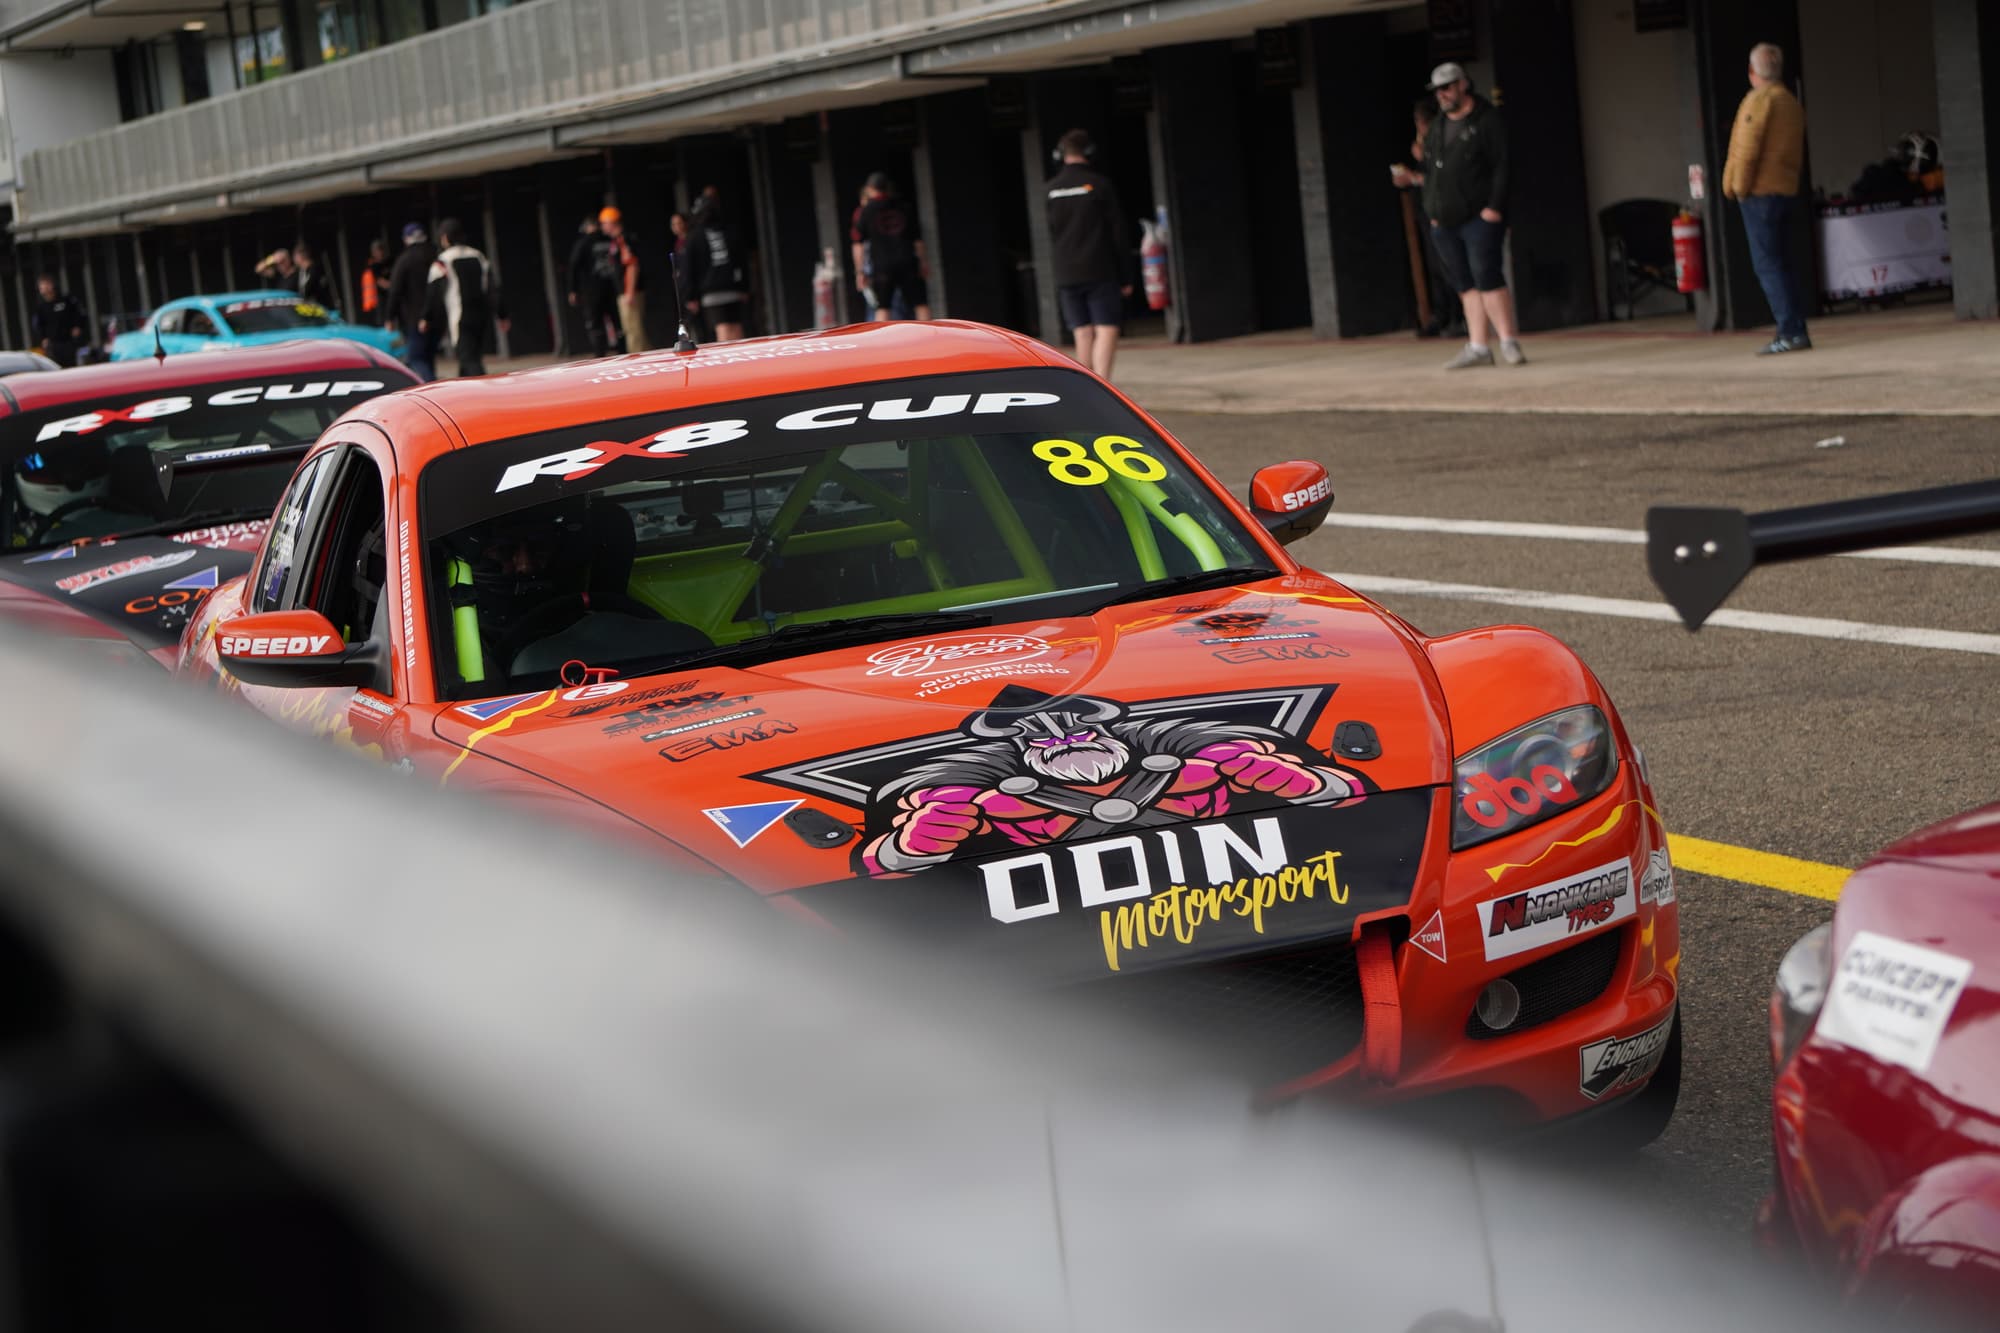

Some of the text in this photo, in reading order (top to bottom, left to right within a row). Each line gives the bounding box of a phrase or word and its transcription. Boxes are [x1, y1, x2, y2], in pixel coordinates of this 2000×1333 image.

[208, 381, 385, 406] CUP
[776, 392, 1061, 431] CUP
[1032, 435, 1168, 486] 86
[221, 635, 331, 655] SPEEDY
[915, 667, 1071, 698] TUGGERANONG
[920, 662, 1054, 689] QUEANBEYAN
[977, 817, 1289, 924] ODIN
[1421, 932, 1441, 943] TOW
